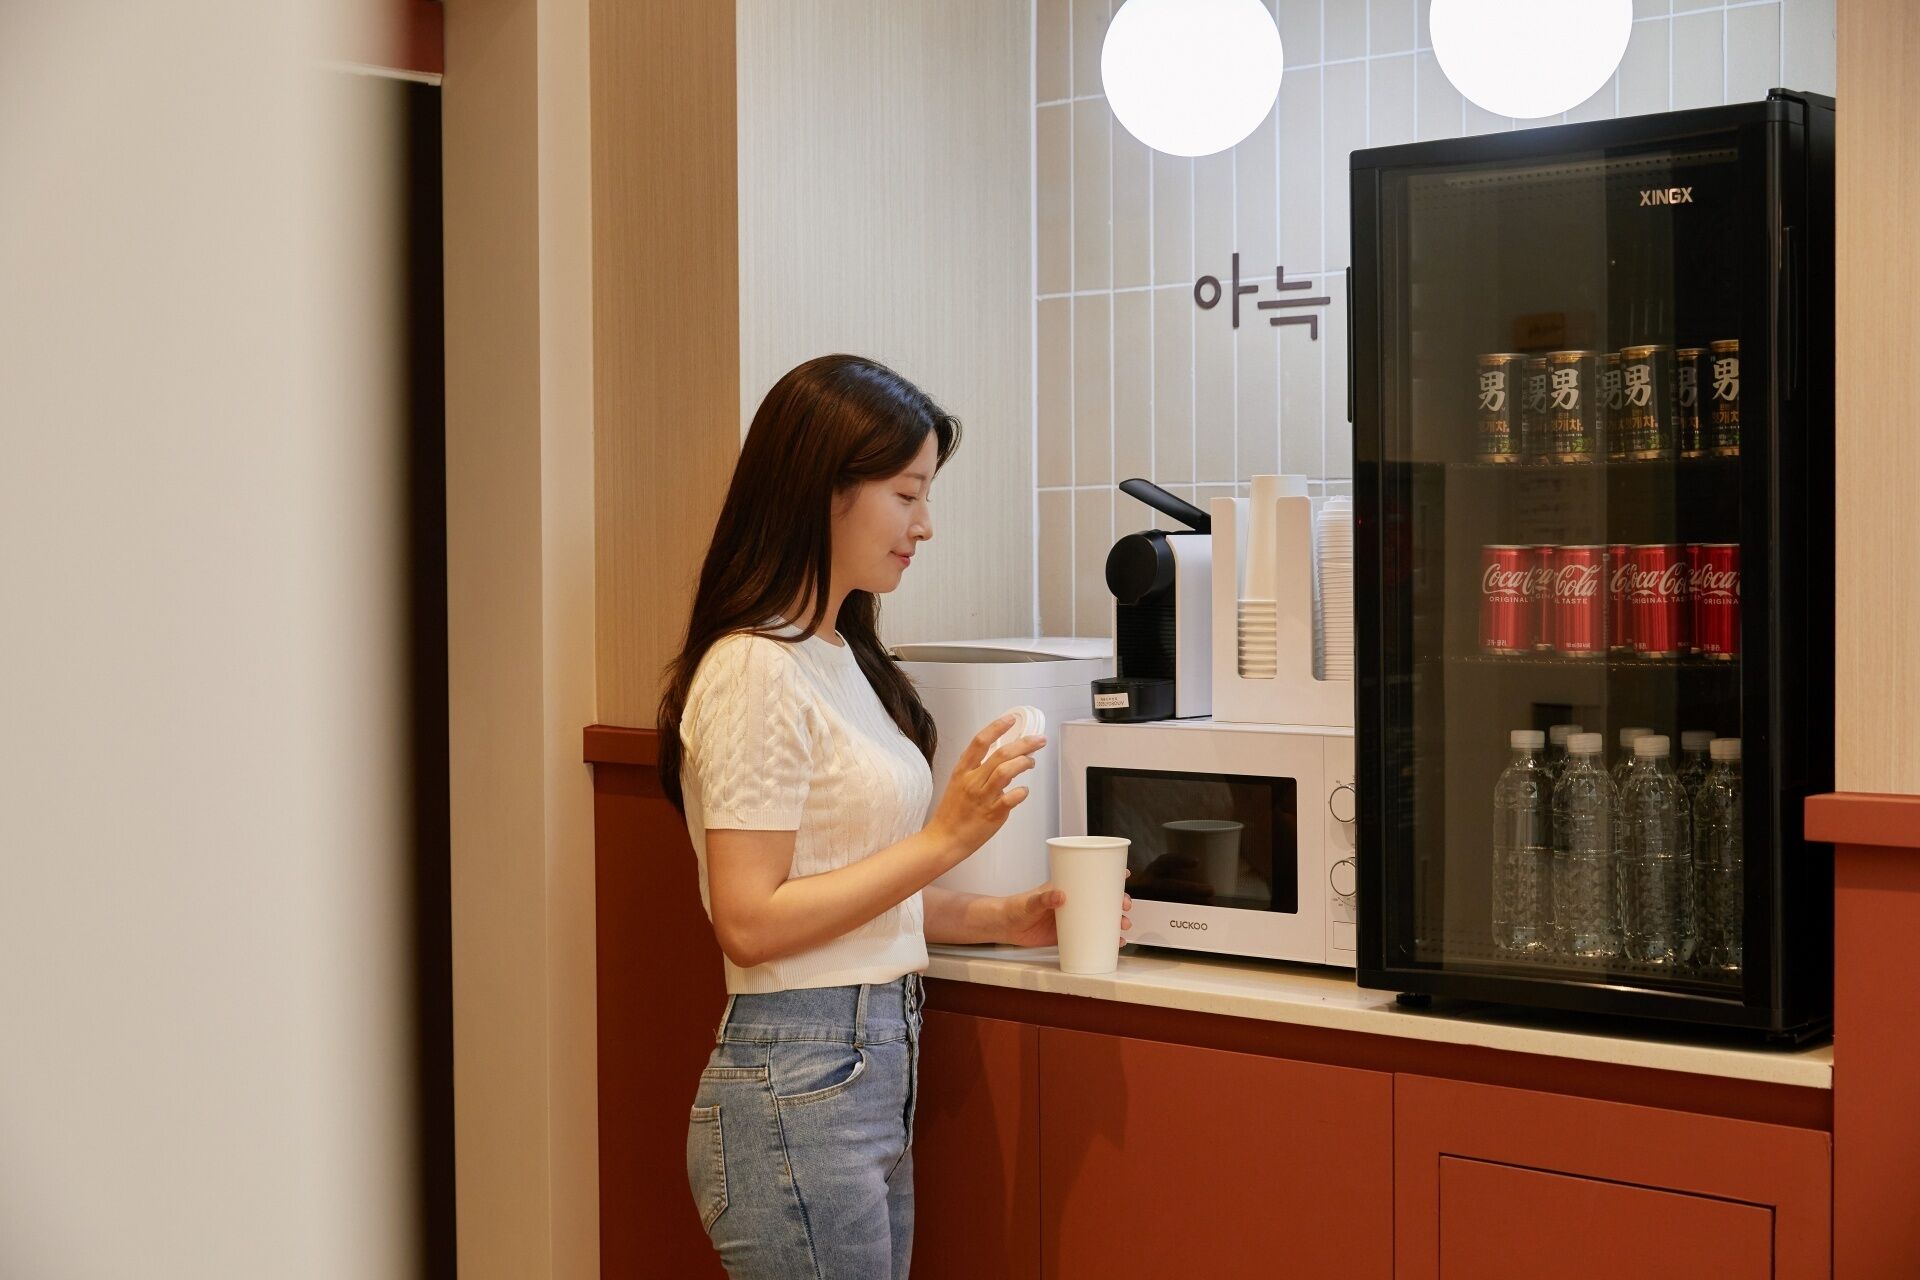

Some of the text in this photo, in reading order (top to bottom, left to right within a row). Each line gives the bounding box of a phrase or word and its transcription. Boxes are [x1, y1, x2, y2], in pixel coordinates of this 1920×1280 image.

[1640, 187, 1693, 206] XINGX
[1194, 253, 1331, 341] 아늑
[1479, 370, 1506, 412] 男
[1550, 368, 1579, 410] 男
[1624, 364, 1652, 407] 男
[1712, 357, 1739, 401] 男
[1170, 920, 1208, 931] CUCKOO
